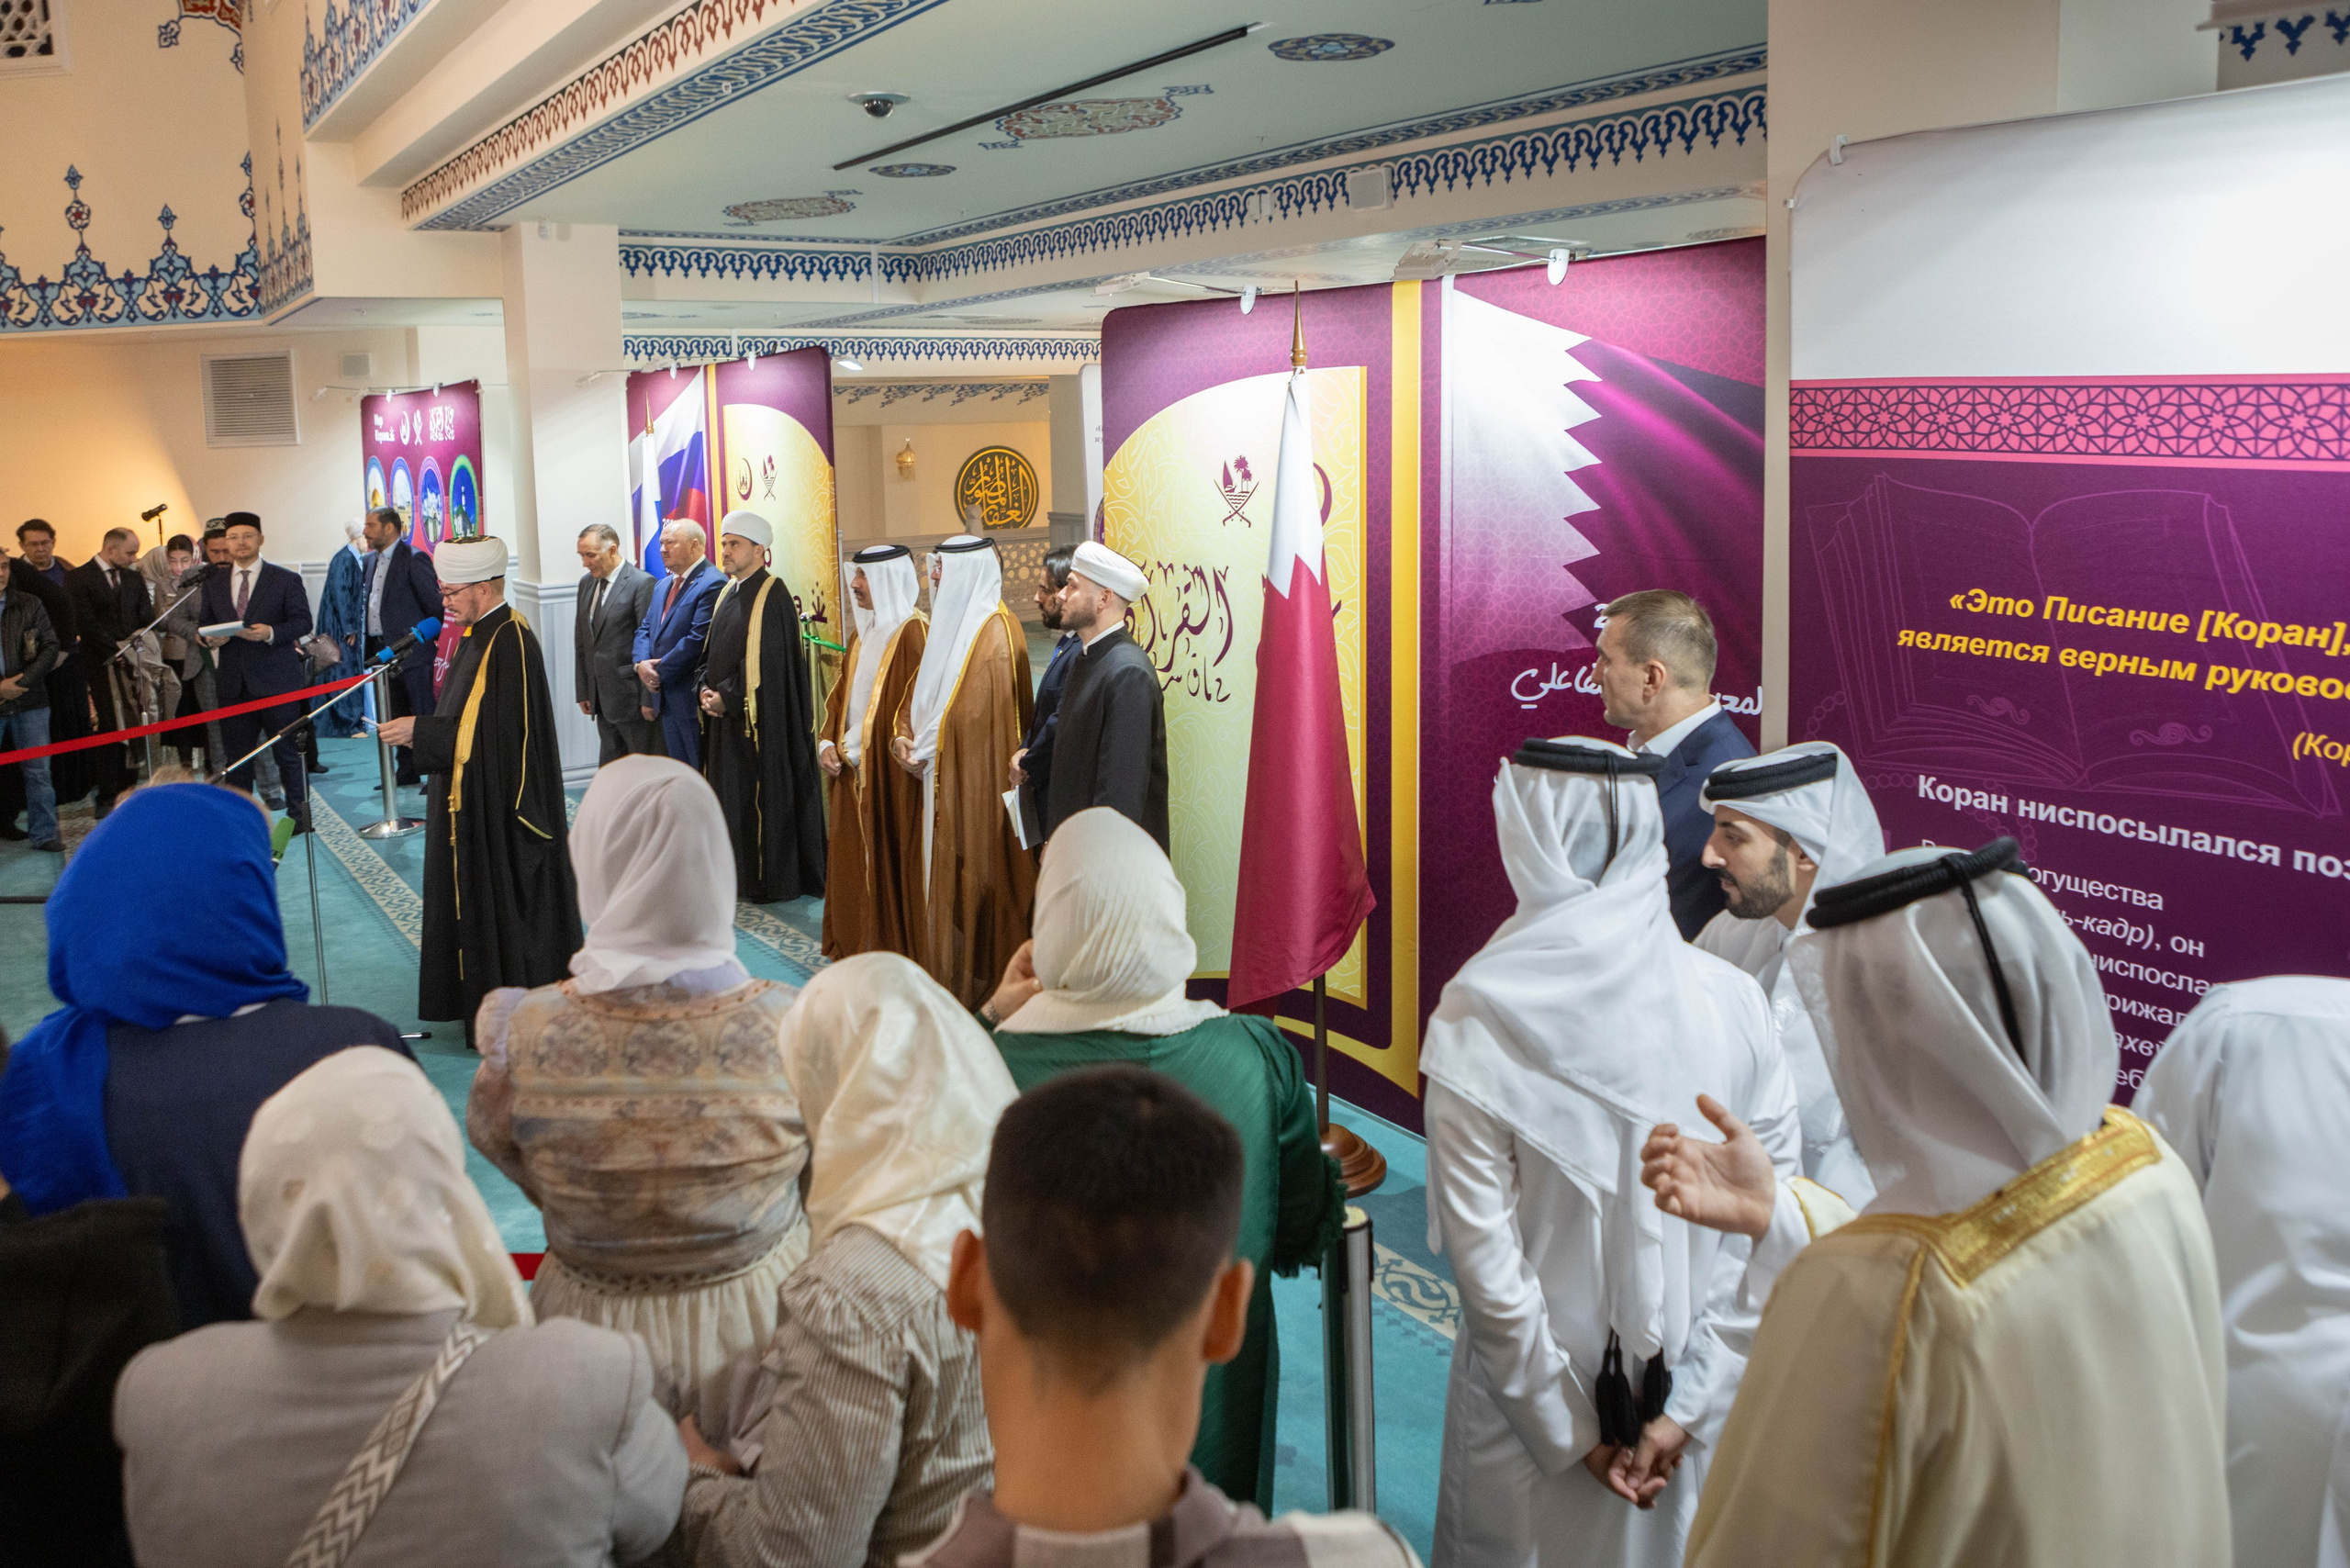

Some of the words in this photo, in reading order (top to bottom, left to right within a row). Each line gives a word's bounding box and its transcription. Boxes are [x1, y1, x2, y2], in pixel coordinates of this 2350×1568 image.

[1949, 588, 2034, 618] «Это
[2042, 595, 2190, 634] Писание
[2196, 610, 2350, 657] [Коран],
[1897, 629, 2051, 664] является
[2059, 647, 2198, 682] верным
[2205, 665, 2350, 700] руково
[1919, 774, 2009, 814] Коран
[2018, 799, 2280, 867] ниспосылался
[2028, 867, 2164, 911] огущества
[2056, 907, 2161, 951] ь-кадр),
[2170, 935, 2204, 958] он
[2092, 954, 2214, 996] испосла
